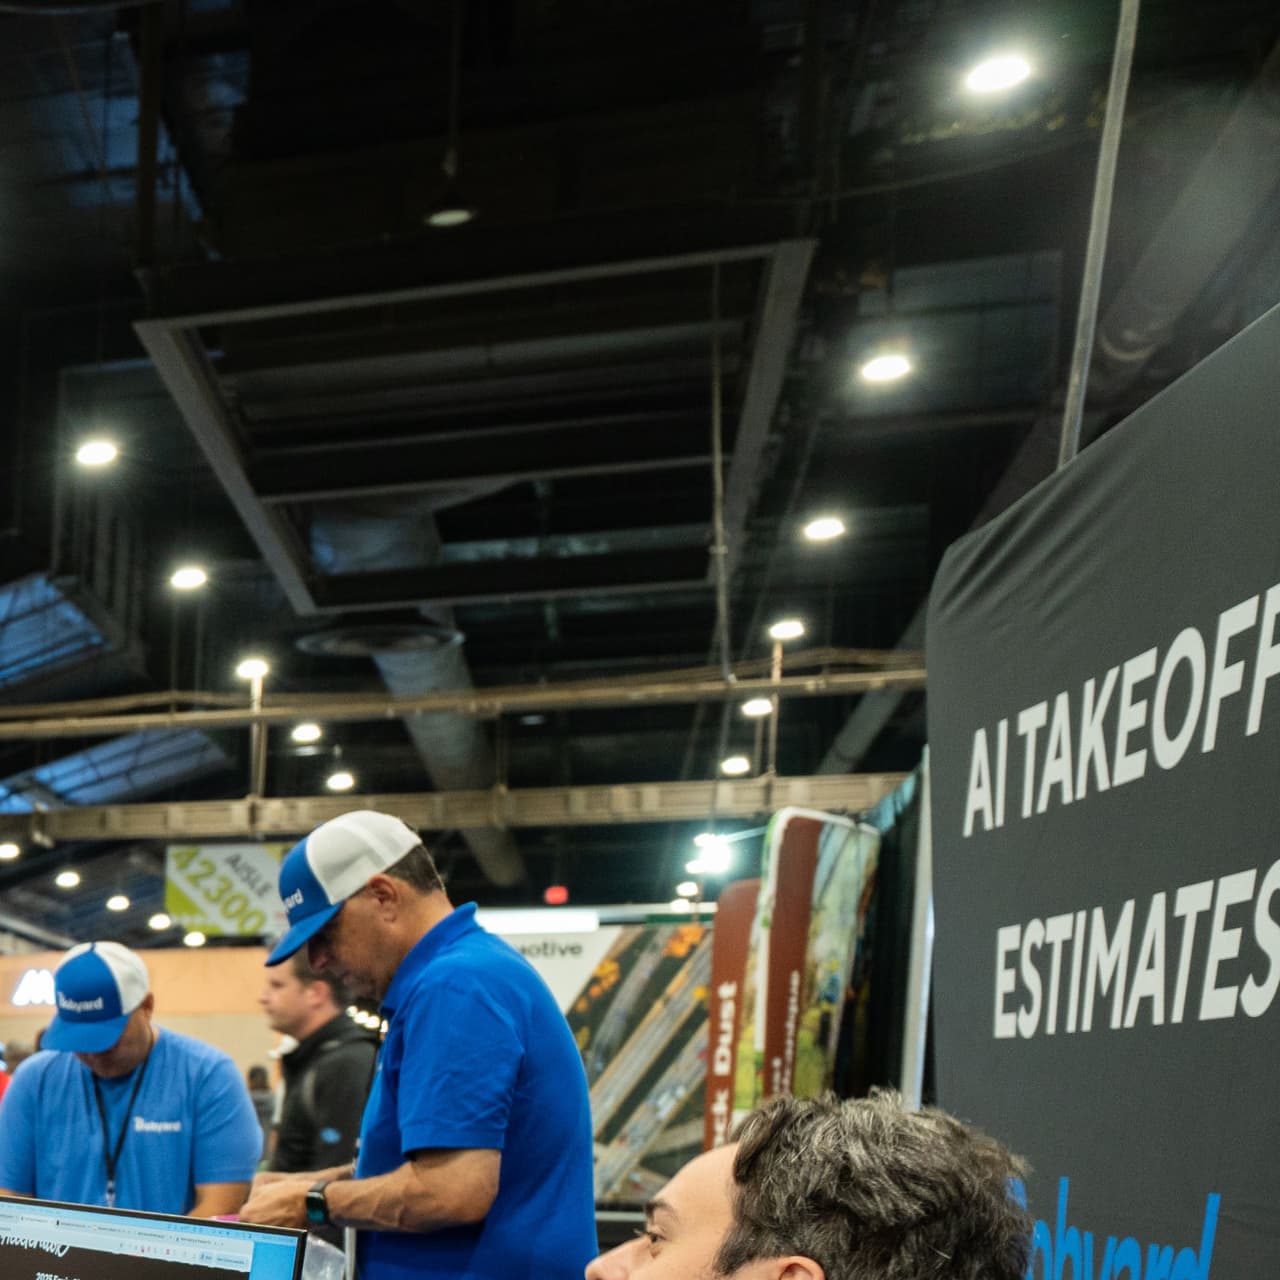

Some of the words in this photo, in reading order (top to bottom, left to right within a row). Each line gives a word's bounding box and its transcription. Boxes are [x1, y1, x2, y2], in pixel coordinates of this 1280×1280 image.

[963, 717, 1008, 838] AI
[170, 846, 266, 937] 42300
[994, 858, 1280, 1039] ESTIMATES
